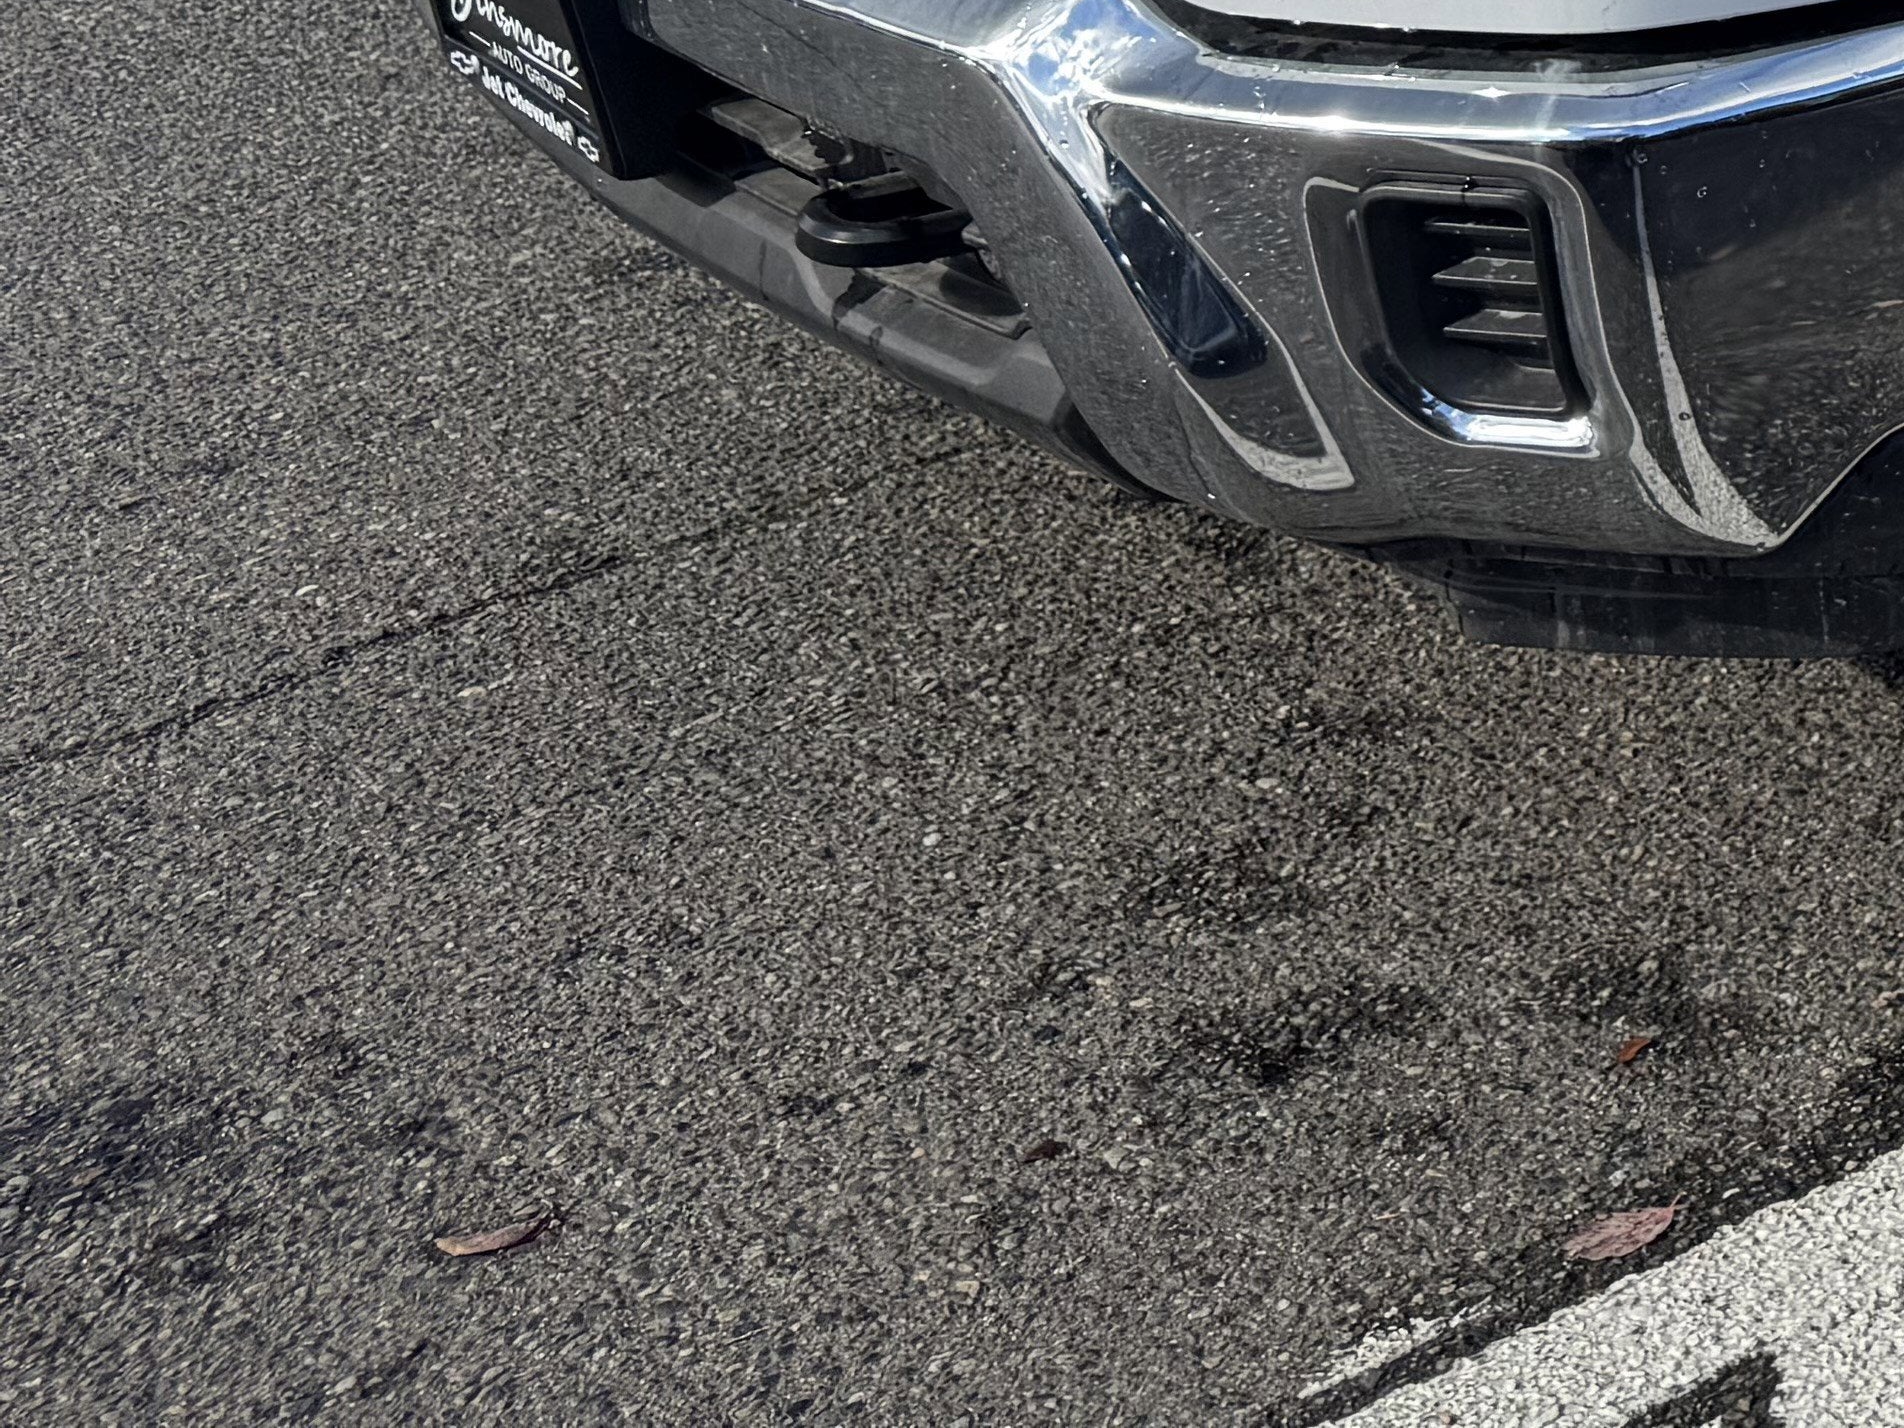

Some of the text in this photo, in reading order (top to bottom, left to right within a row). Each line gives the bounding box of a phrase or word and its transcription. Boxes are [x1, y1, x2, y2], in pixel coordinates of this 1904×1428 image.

[481, 65, 574, 146] Jet Chevrolet
[489, 41, 566, 104] AUTO GROUP
